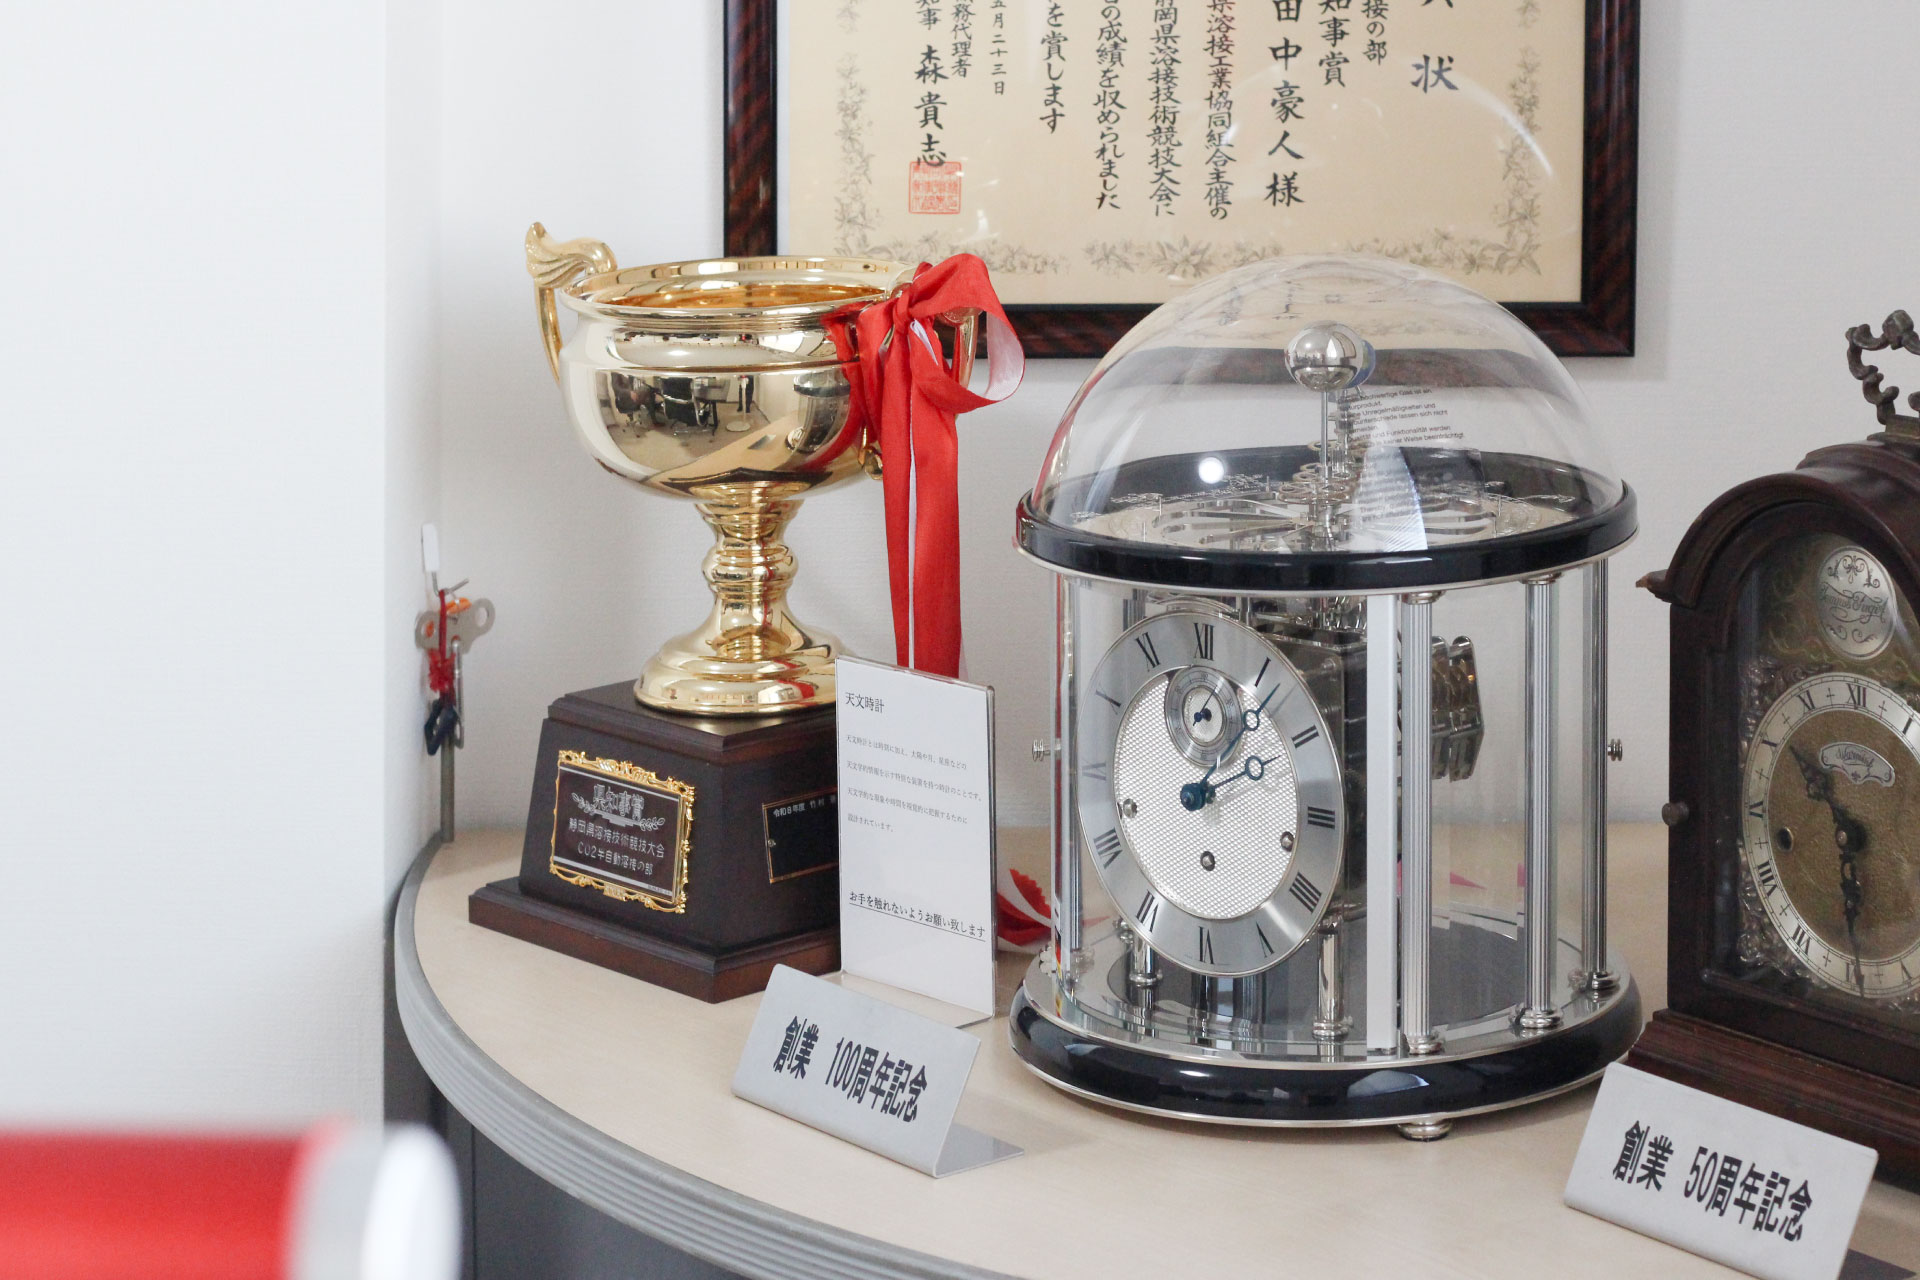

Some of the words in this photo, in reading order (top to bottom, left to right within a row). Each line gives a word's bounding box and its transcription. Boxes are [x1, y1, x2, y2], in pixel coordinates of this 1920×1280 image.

[951, 0, 976, 78] 務代理者
[1039, 3, 1069, 134] を賞します
[1361, 0, 1389, 65] 接の部
[914, 45, 950, 167] 森貴志
[1093, 0, 1128, 210] の成績を収められました
[1264, 0, 1305, 207] 田中豪人様
[845, 691, 885, 714] 天文時計
[849, 890, 986, 938] お手を触れないようお願い致します
[772, 1015, 820, 1080] 創業
[825, 1036, 928, 1123] 100周年記念
[1612, 1119, 1674, 1192] 創業
[1684, 1145, 1813, 1242] 50周年記念
